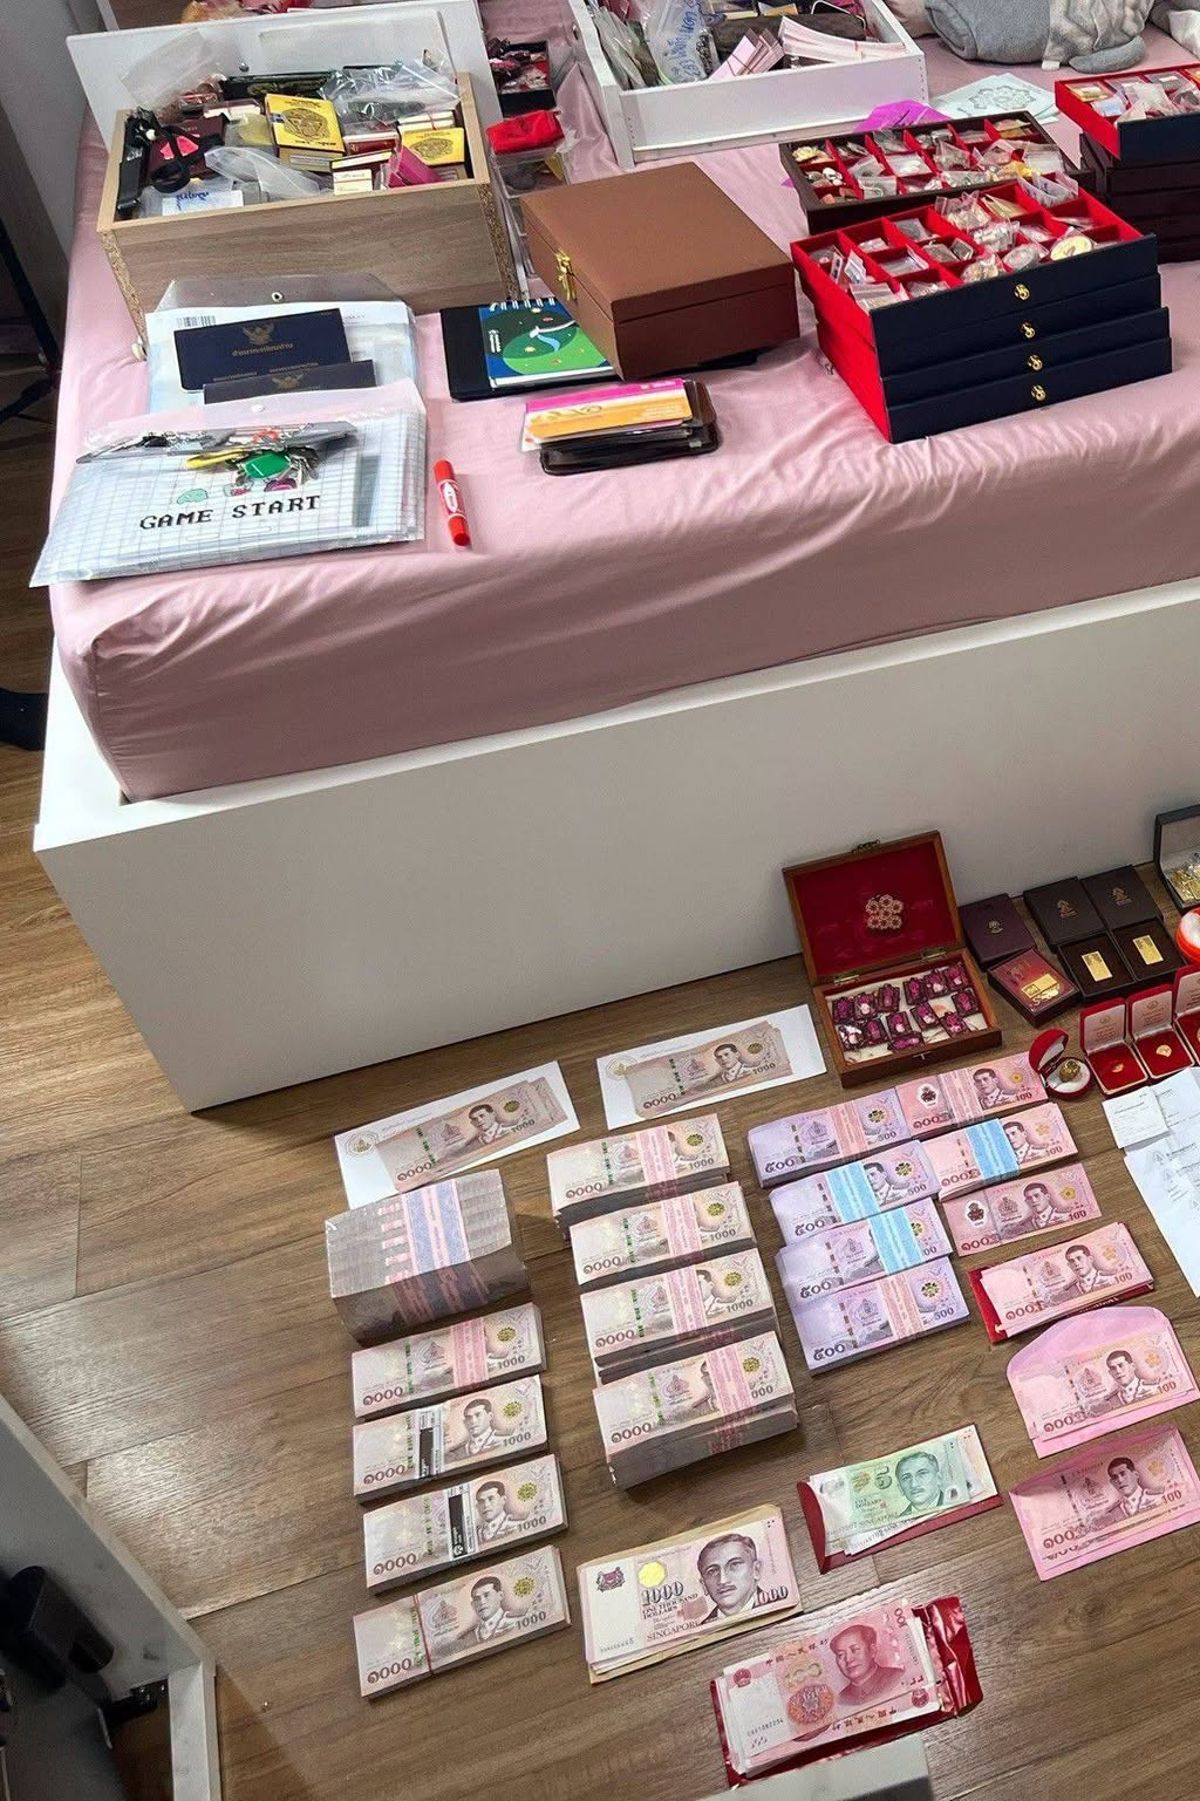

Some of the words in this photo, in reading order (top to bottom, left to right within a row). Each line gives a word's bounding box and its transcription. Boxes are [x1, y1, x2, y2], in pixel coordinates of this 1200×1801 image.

[139, 508, 214, 530] GAME
[231, 494, 321, 522] START
[1068, 1210, 1087, 1222] 100
[710, 1228, 736, 1243] 1000
[1114, 1272, 1133, 1284] 100
[726, 1299, 754, 1314] 1000
[934, 1307, 954, 1321] 500
[1157, 1381, 1177, 1394] 100
[502, 1431, 532, 1447] 1000
[874, 1466, 892, 1490] 5
[1163, 1490, 1183, 1504] 100
[517, 1516, 548, 1532] 1000
[640, 1581, 684, 1606] 1000
[515, 1611, 548, 1630] 1000
